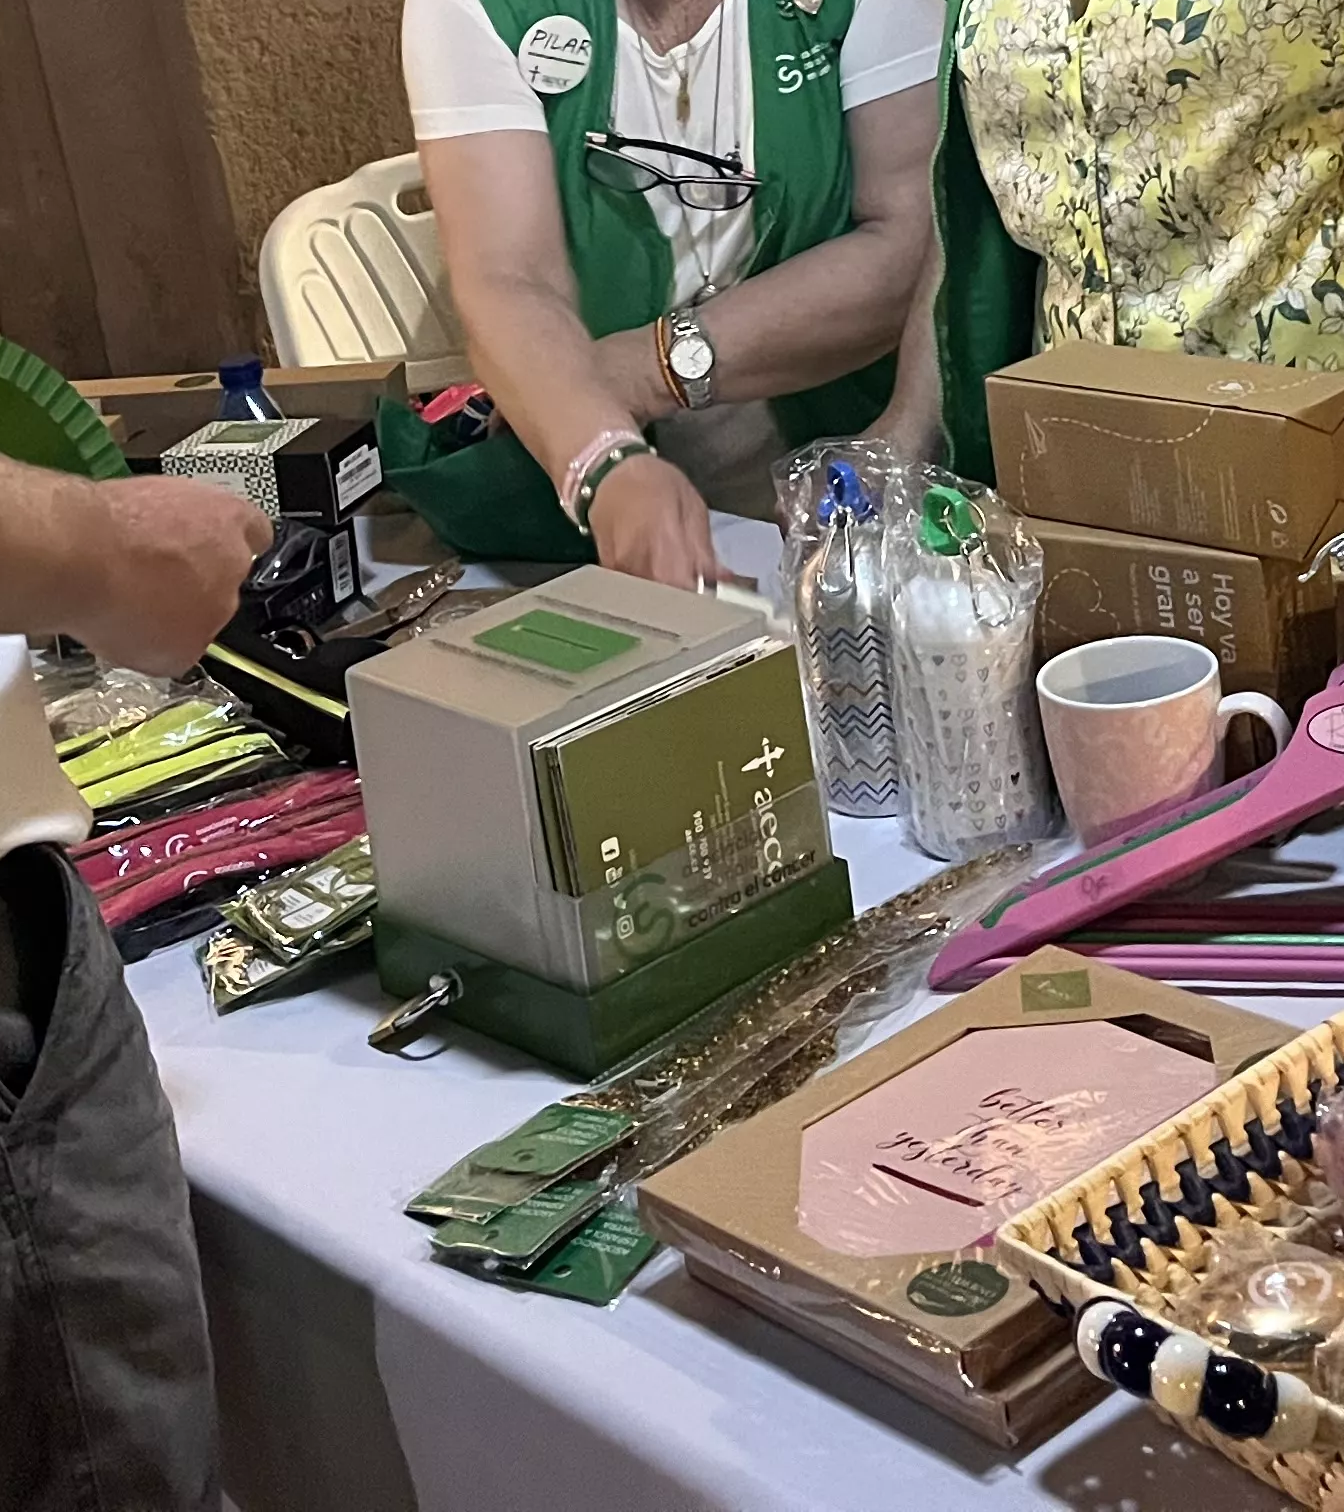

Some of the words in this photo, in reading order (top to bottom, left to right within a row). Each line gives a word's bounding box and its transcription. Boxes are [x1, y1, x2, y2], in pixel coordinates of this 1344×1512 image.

[529, 29, 592, 57] PILAR
[1182, 568, 1200, 585] a
[1148, 565, 1175, 628] gran
[1211, 573, 1235, 628] Hoy
[1185, 592, 1205, 637] ser
[1219, 633, 1236, 664] va
[744, 874, 761, 898] el
